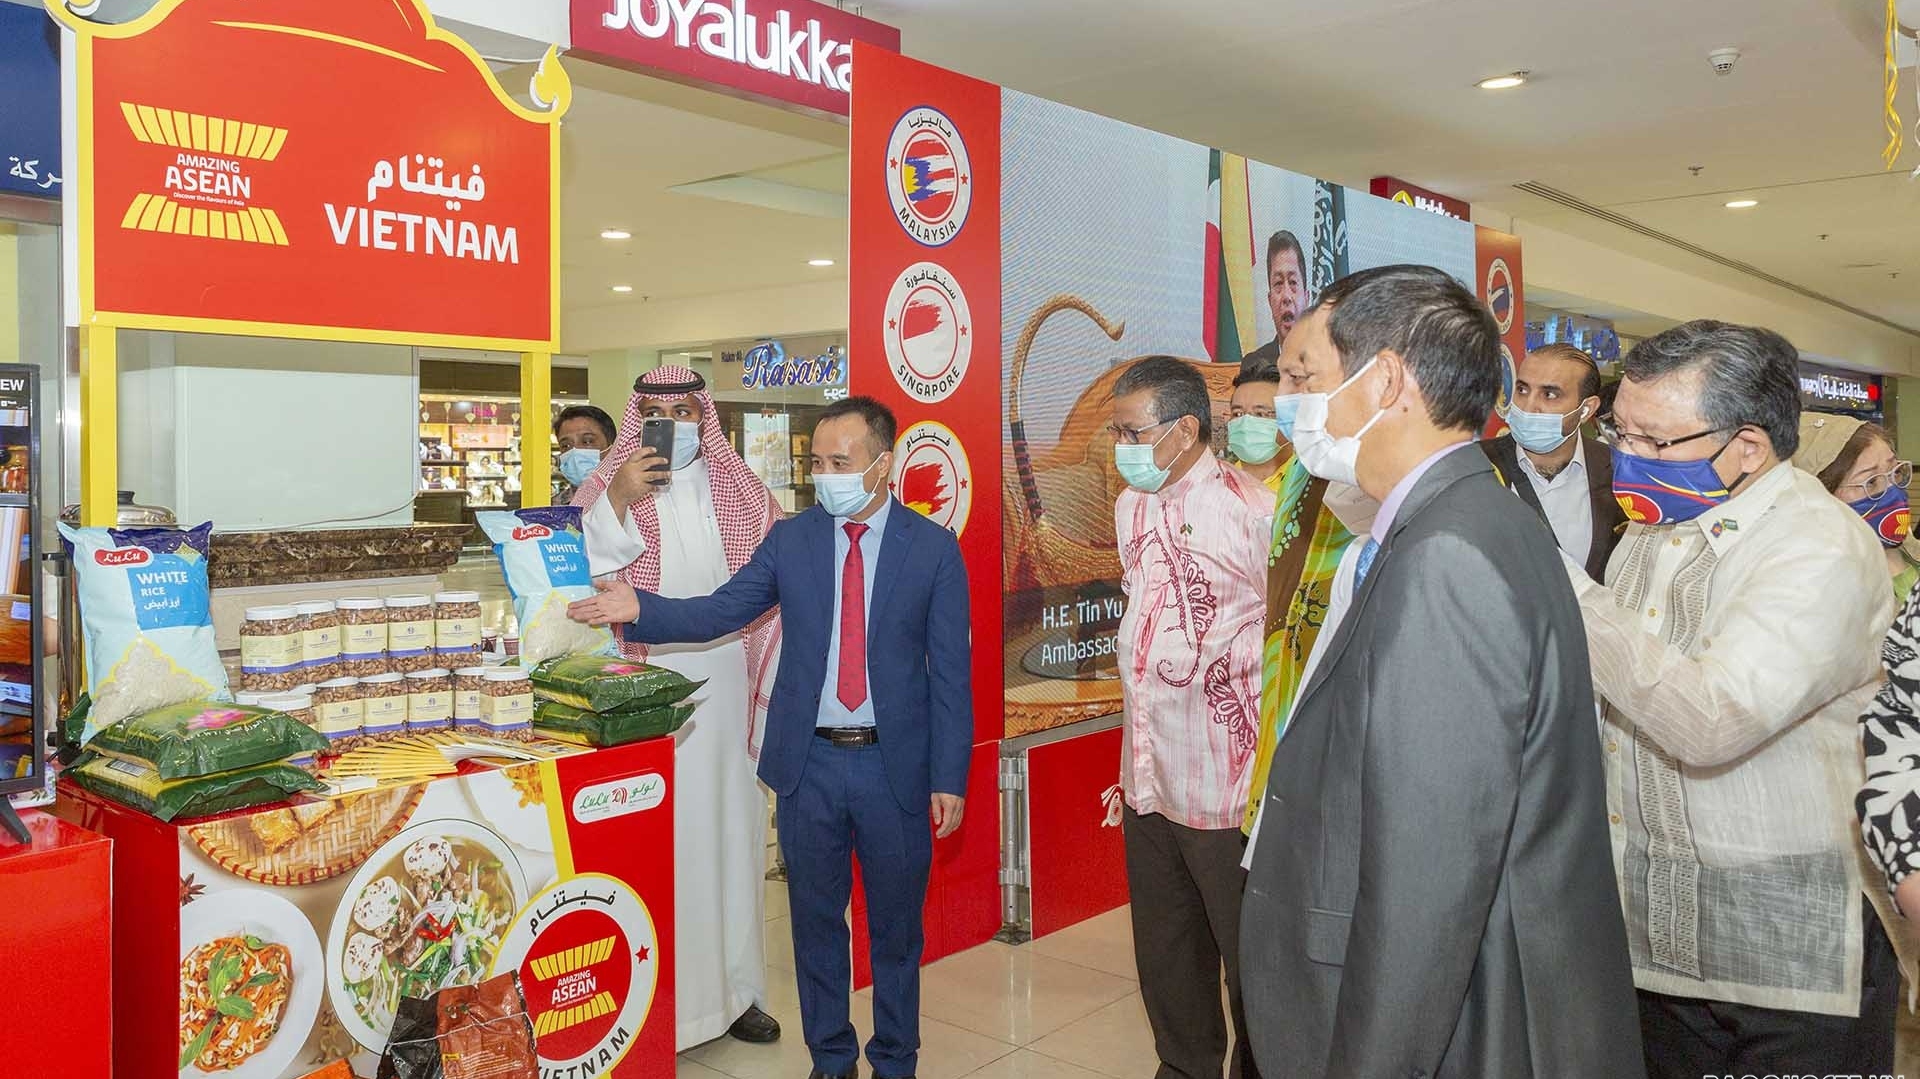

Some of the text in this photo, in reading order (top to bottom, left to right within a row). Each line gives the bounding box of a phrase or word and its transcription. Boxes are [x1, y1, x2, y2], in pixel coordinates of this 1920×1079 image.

[908, 112, 952, 138] ماليزيا
[9, 156, 64, 188] ركة
[176, 153, 240, 173] AMAZING
[165, 165, 251, 199] ASEAN
[367, 153, 485, 211] فيتنام
[324, 203, 519, 264] VIETNAM
[899, 206, 957, 241] MALAYSIA
[742, 342, 838, 390] Rasasi
[897, 364, 960, 397] SINGAPORE
[906, 428, 951, 453] فيتنام
[104, 551, 141, 563] LuLu
[544, 544, 580, 554] WHITE
[549, 555, 567, 563] RICE
[136, 571, 189, 585] WHITE
[140, 586, 167, 597] RICE
[1042, 597, 1123, 630] H.E. Tin Yu
[529, 889, 617, 937] فيتنام
[551, 976, 597, 1005] ASEAN
[557, 969, 591, 988] AMAZING
[537, 1026, 630, 1079] IETNAM
